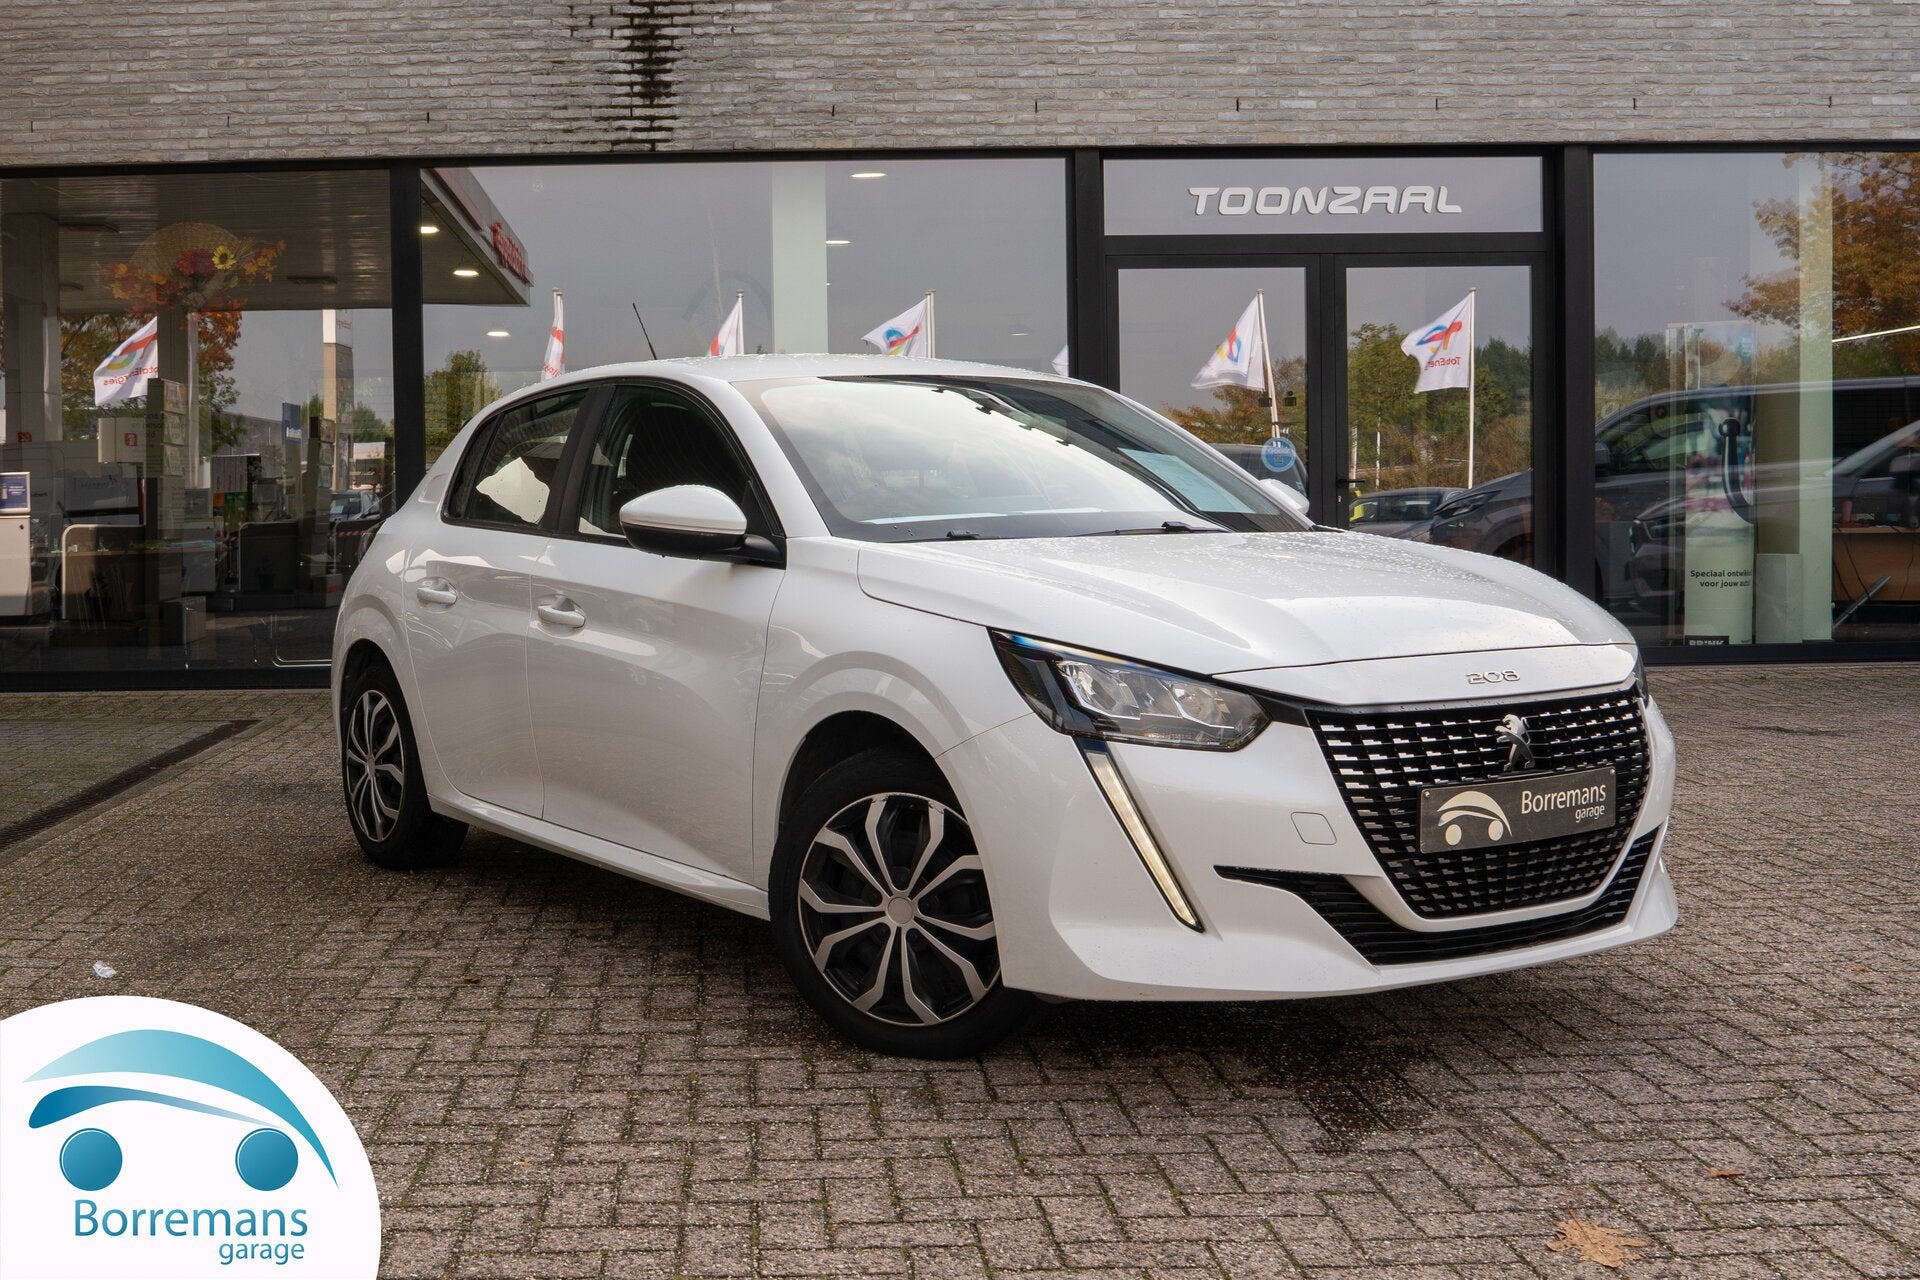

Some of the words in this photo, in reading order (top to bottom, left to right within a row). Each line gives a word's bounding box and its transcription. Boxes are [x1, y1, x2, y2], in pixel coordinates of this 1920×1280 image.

[1188, 185, 1462, 215] TOONZAAL
[1690, 570, 1726, 578] Speciaal
[1720, 580, 1739, 588] jouw
[1466, 669, 1520, 685] 208
[1521, 784, 1606, 815] Borremans
[1575, 804, 1605, 823] garage
